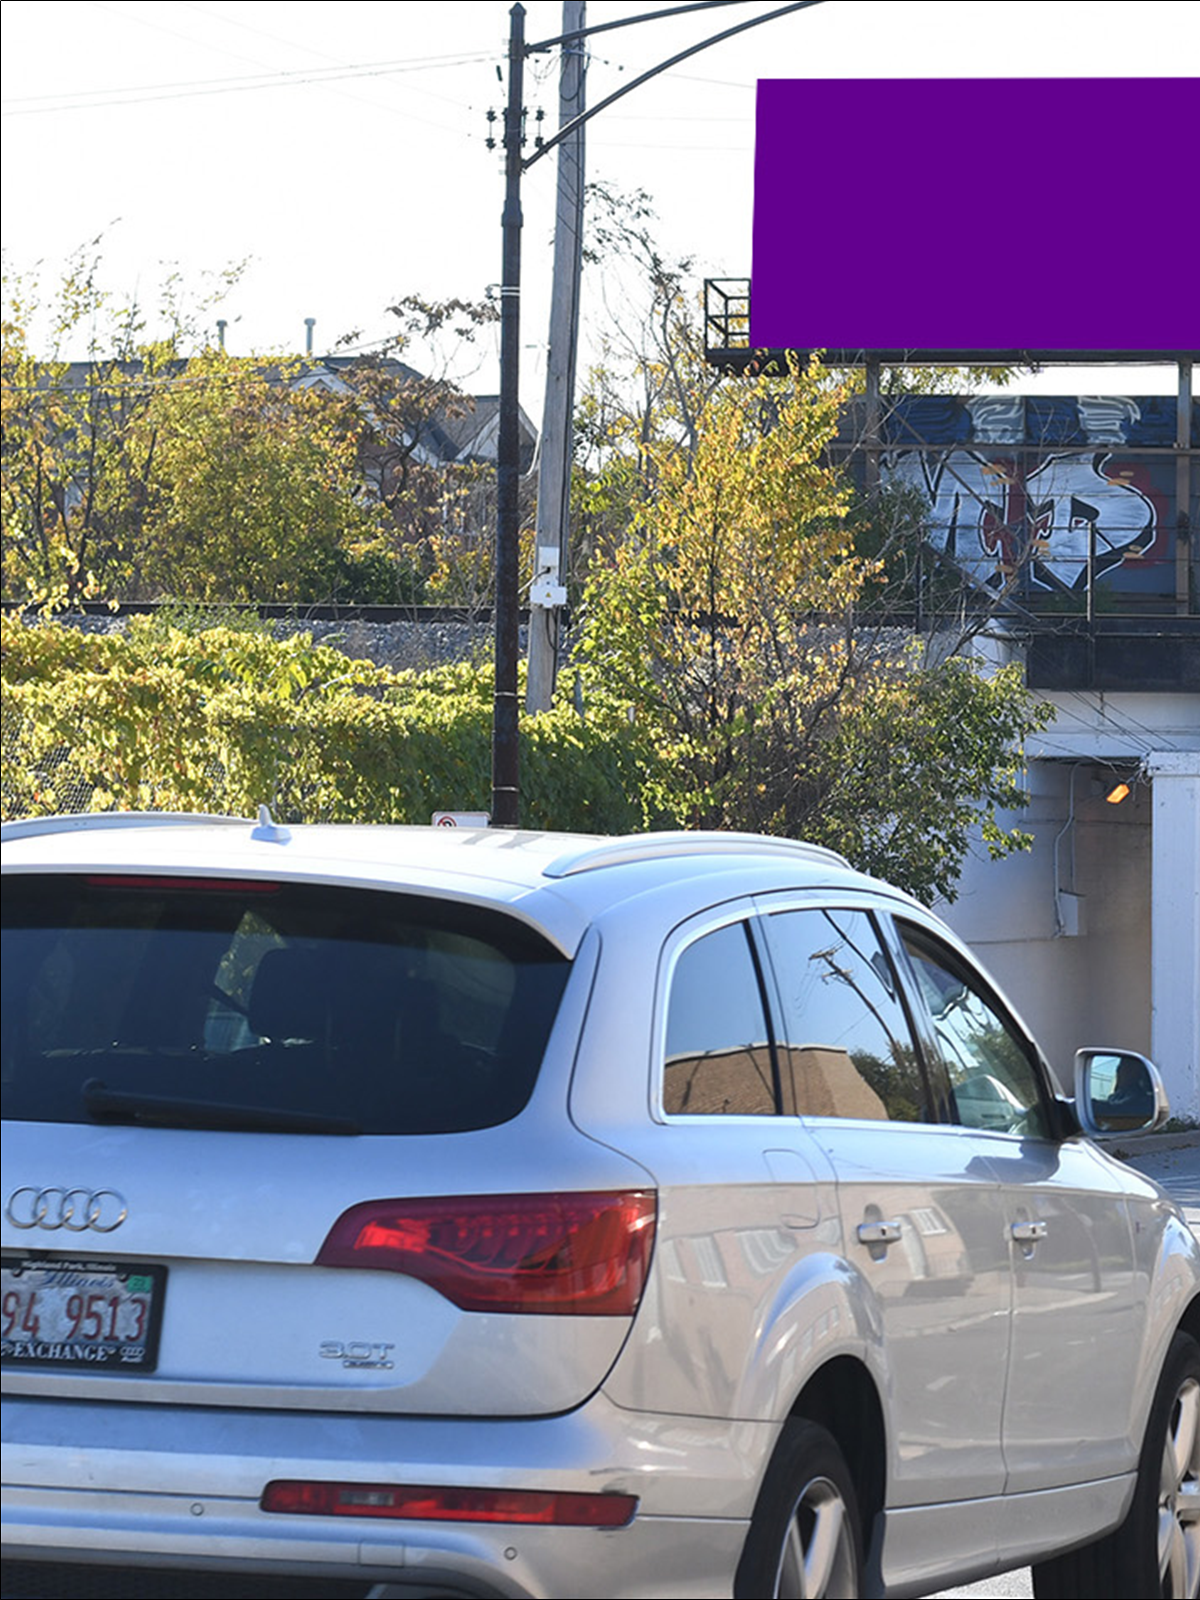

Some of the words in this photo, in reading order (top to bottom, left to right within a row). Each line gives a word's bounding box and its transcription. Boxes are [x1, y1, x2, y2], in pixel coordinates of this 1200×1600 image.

[40, 1272, 116, 1288] Illinois
[2, 1291, 40, 1338] 94
[66, 1294, 147, 1342] 9513
[13, 1341, 109, 1362] EXCHANGE
